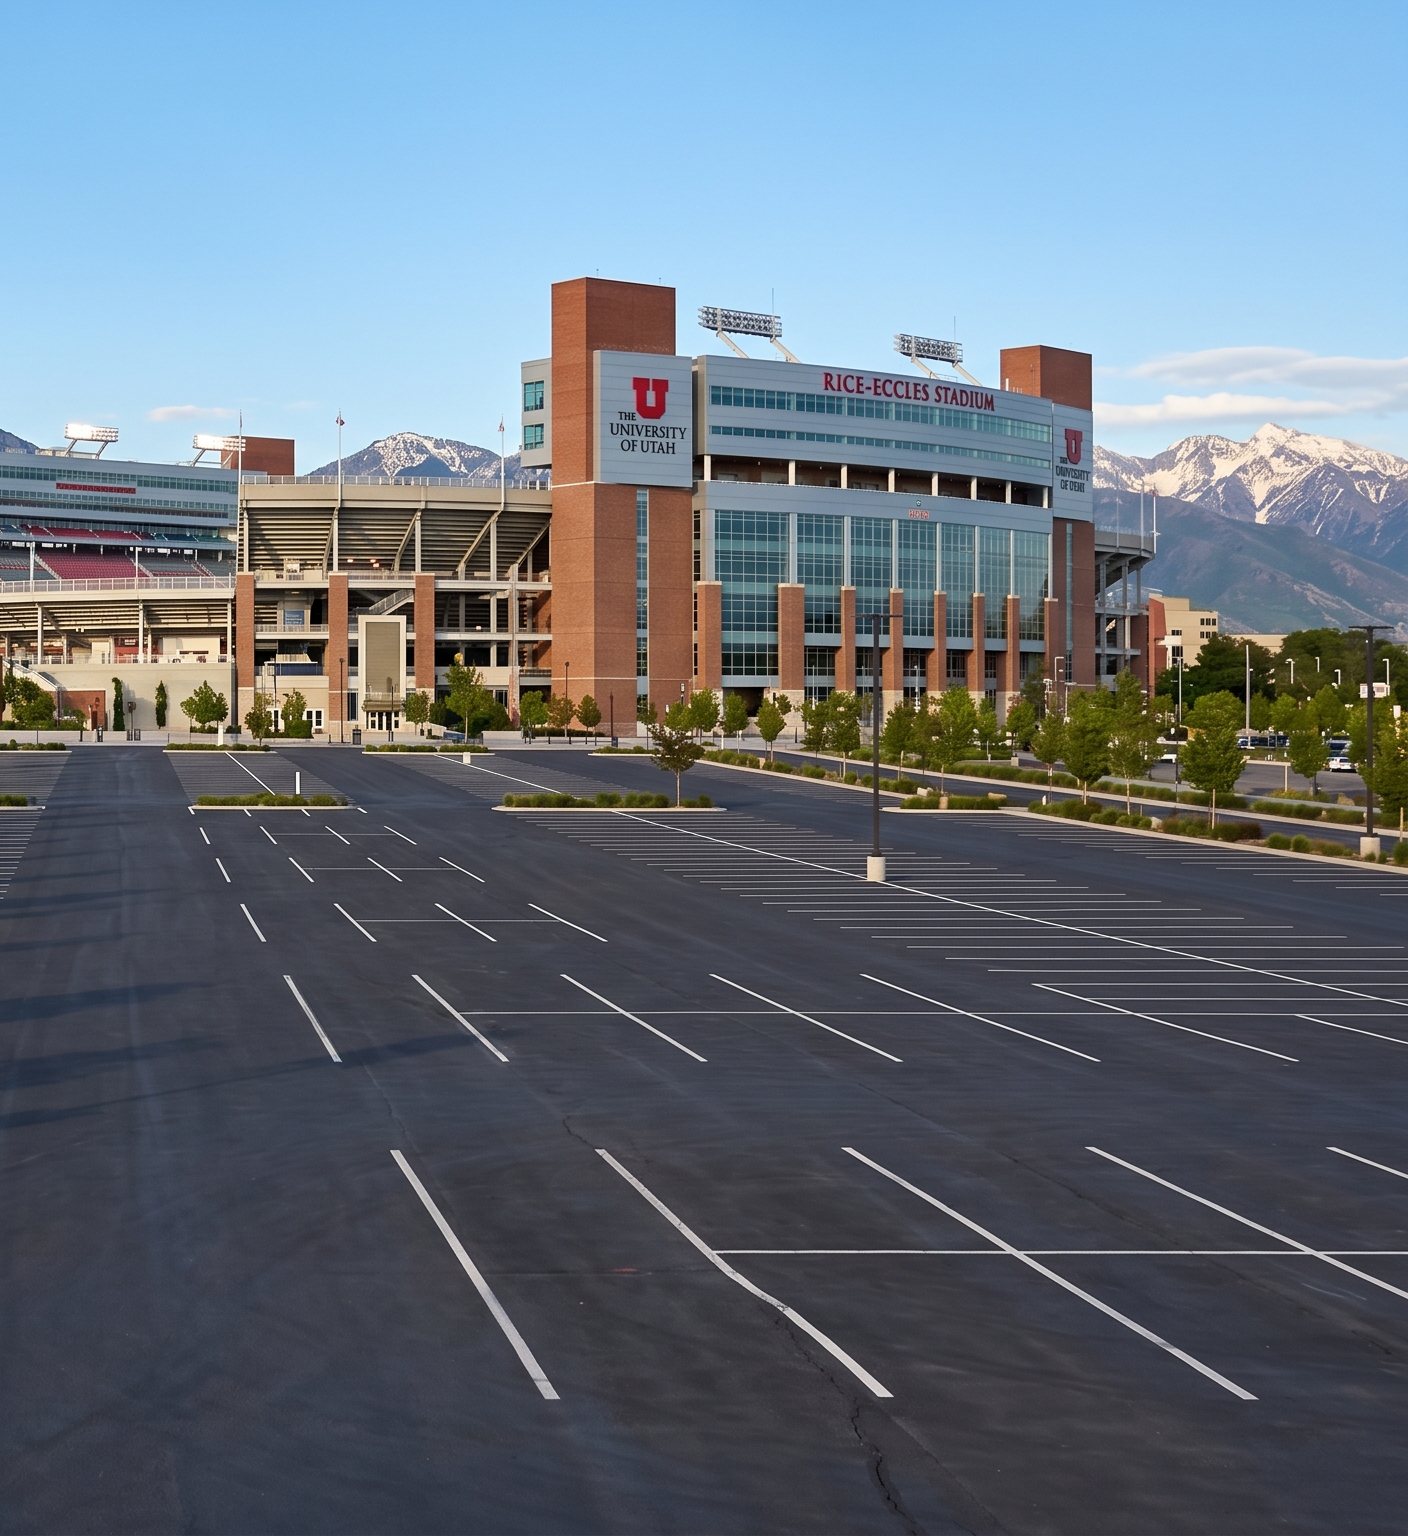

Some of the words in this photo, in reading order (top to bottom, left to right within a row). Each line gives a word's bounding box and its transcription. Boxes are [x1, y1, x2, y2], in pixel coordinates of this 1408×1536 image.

[632, 376, 669, 420] U
[822, 372, 930, 401] RICE-ECCLES
[934, 385, 995, 412] STADIUM
[618, 411, 637, 421] THE
[609, 423, 687, 439] UNIVERSITY
[620, 439, 638, 452] OF
[640, 440, 676, 455] UTAH
